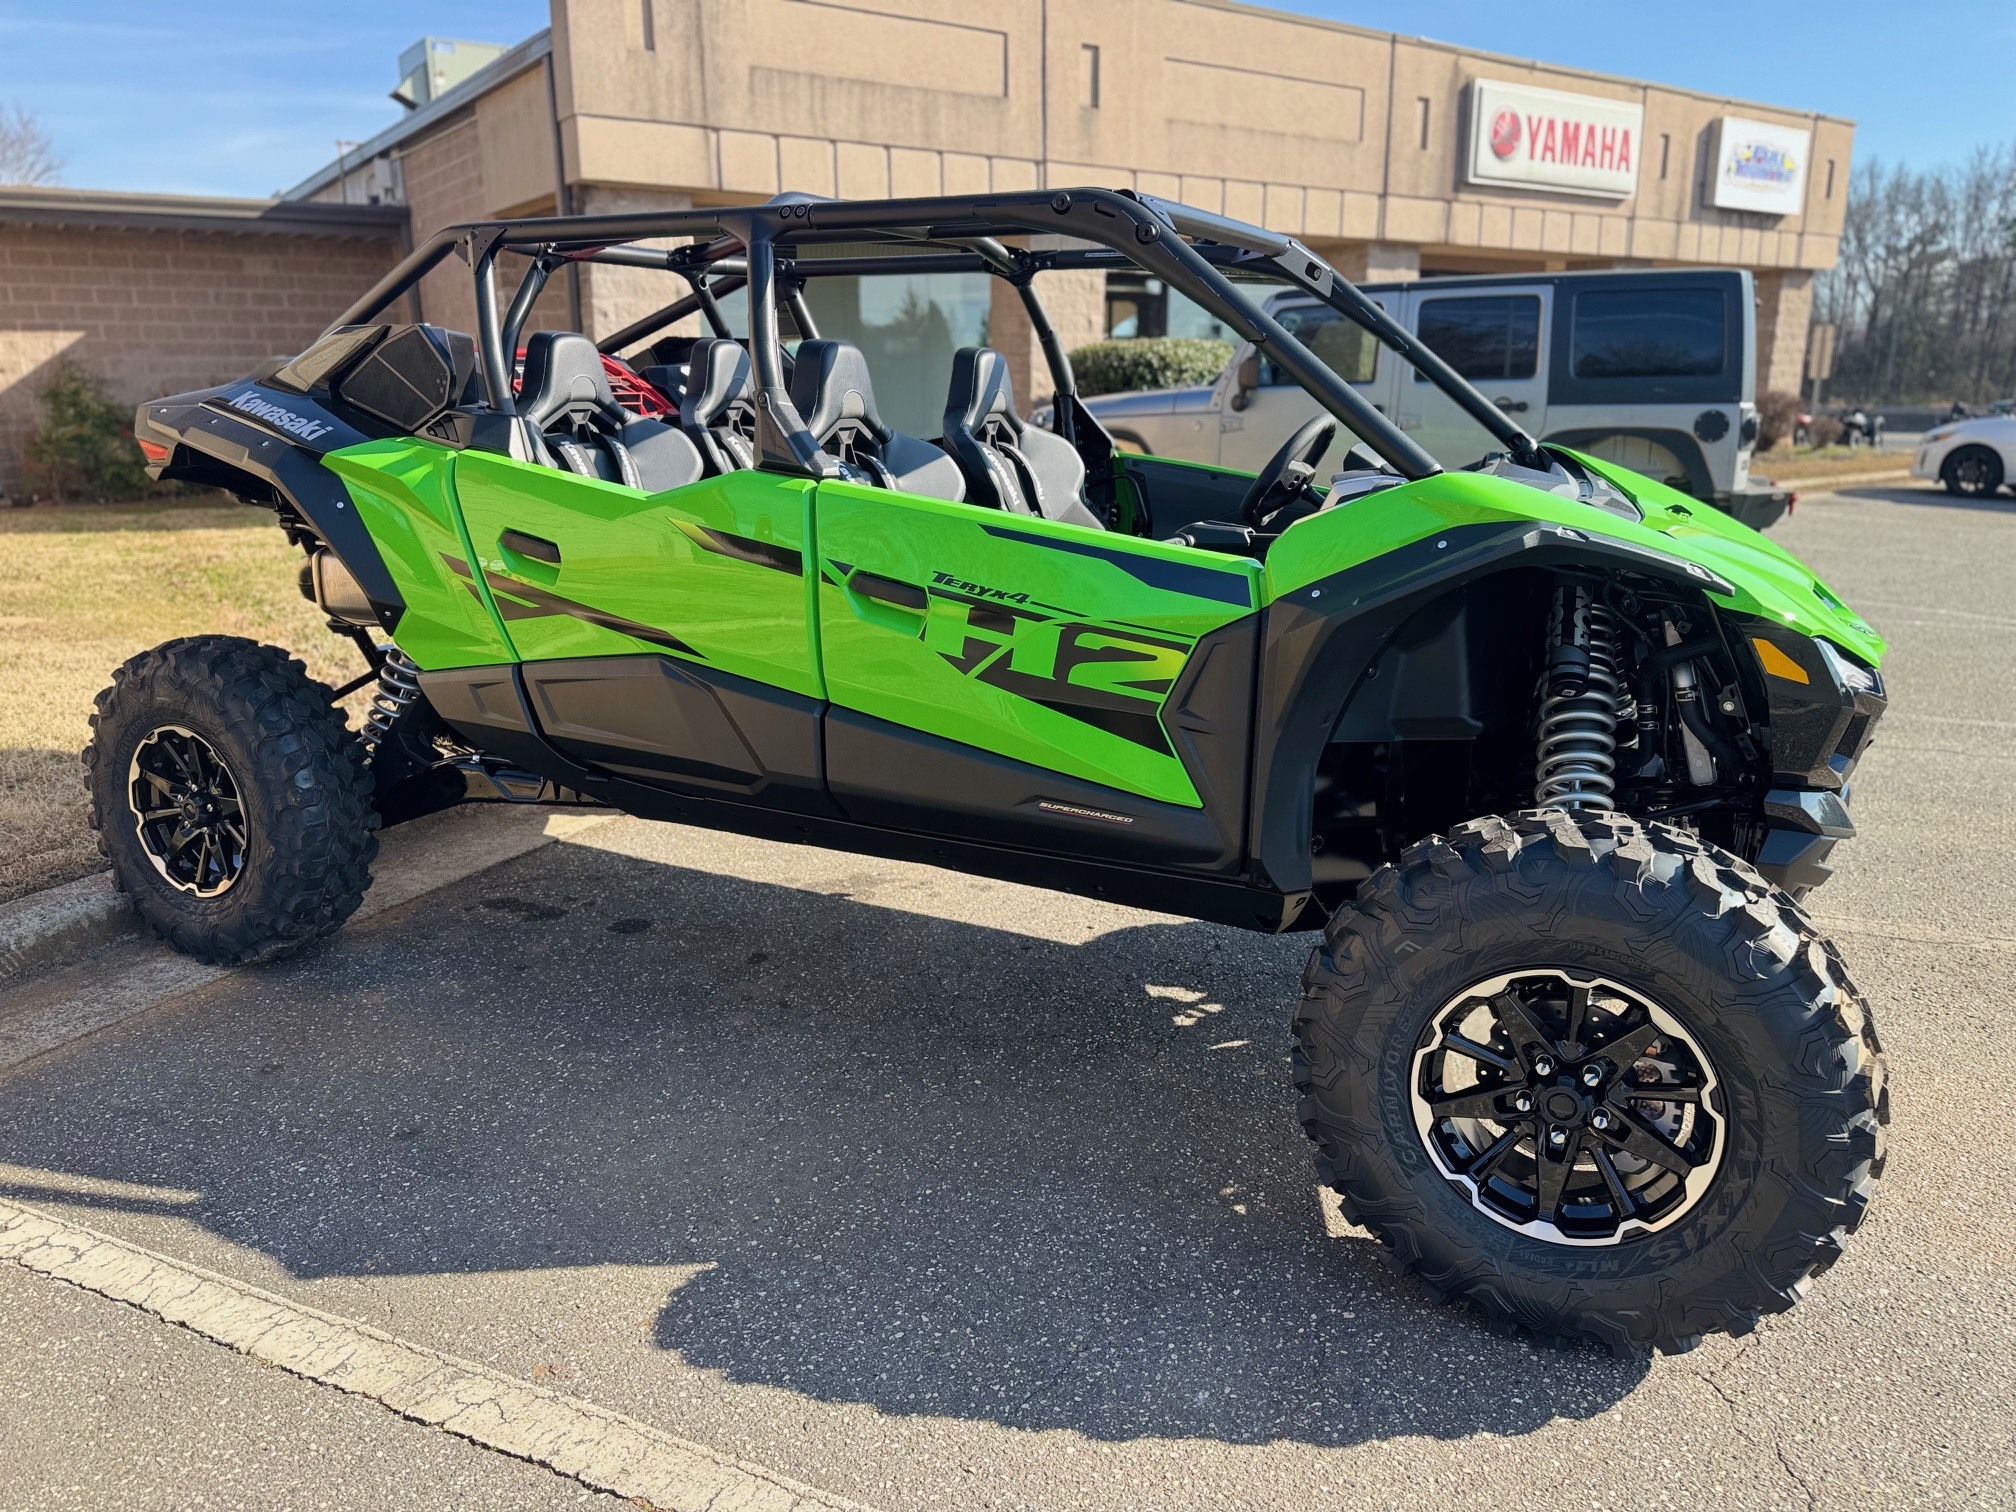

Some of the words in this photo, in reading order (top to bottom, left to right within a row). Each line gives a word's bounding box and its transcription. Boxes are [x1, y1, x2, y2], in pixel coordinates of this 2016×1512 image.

[1527, 114, 1631, 173] YAMAHA
[227, 390, 335, 441] Kawasaki
[983, 447, 1020, 506] Kawasaki
[922, 592, 1187, 703] H2
[1039, 801, 1134, 824] SUPERCHARGED
[1384, 1017, 1418, 1165] CARNIVORE
[1649, 1078, 1758, 1267] MAXXIS
